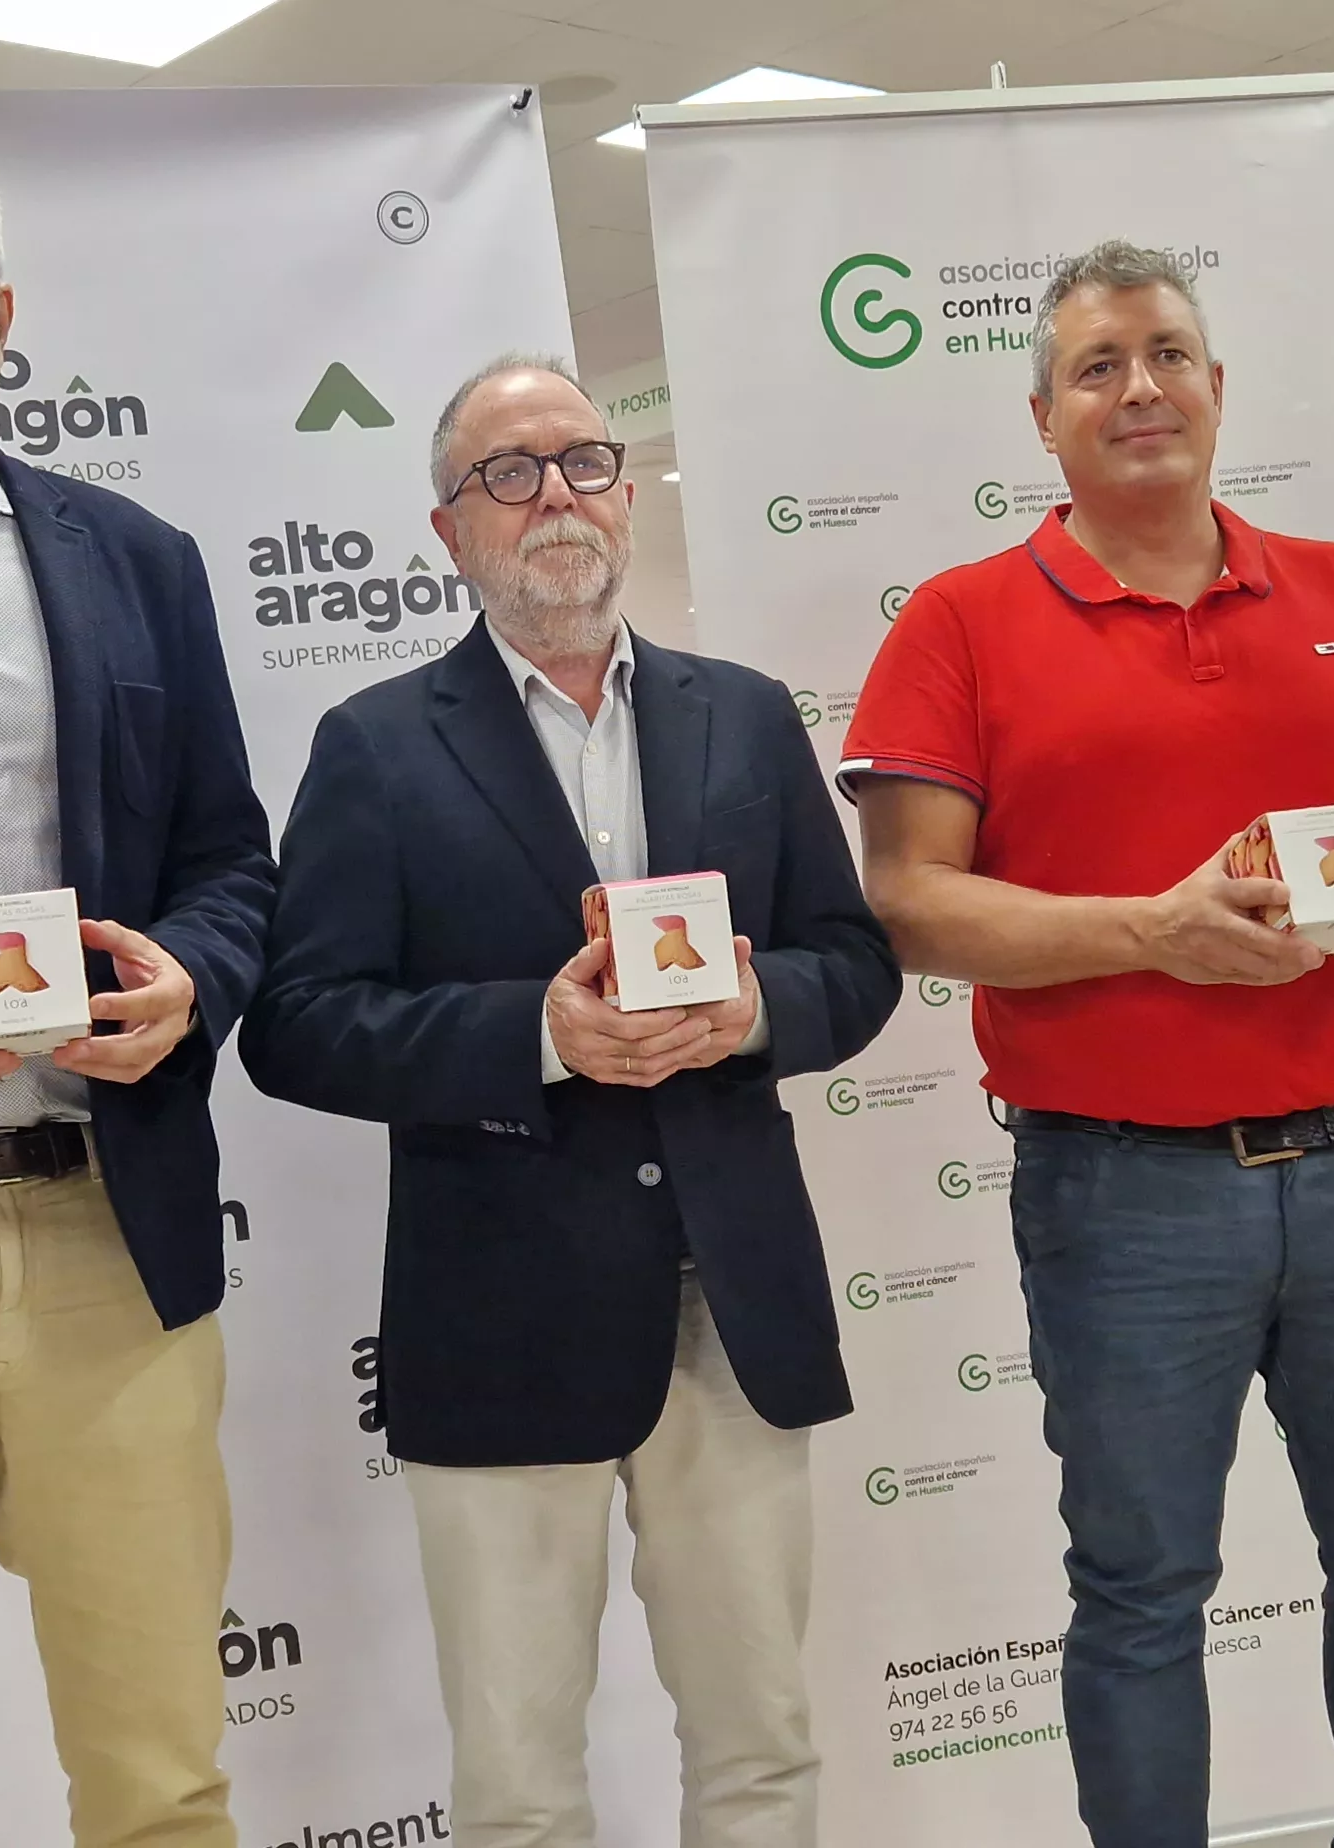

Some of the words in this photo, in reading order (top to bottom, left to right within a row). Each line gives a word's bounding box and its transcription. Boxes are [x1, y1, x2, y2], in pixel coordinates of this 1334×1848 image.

[942, 293, 1031, 319] contra
[946, 332, 979, 354] en
[607, 401, 616, 420] Y
[1218, 463, 1267, 476] asociación
[1269, 459, 1311, 472] española
[1013, 481, 1061, 492] asociación
[1219, 477, 1249, 487] contra
[1251, 475, 1259, 484] el
[1261, 473, 1293, 483] cáncer
[807, 493, 856, 506] asociación
[857, 492, 899, 505] española
[1013, 493, 1043, 503] contra
[1045, 492, 1053, 501] el
[1220, 490, 1232, 498] en
[1233, 487, 1268, 497] Huesca
[808, 507, 839, 518] contra
[840, 506, 848, 516] el
[850, 504, 881, 515] cáncer
[1015, 505, 1027, 514] en
[809, 519, 822, 529] en
[824, 518, 857, 528] Huesca
[248, 521, 373, 577] alto
[262, 636, 461, 670] SUPERMERCADO
[959, 994, 970, 1002] en
[865, 1073, 913, 1087] asociación
[914, 1068, 956, 1082] española
[866, 1088, 895, 1098] contra
[897, 1085, 905, 1094] el
[906, 1082, 938, 1093] cáncer
[867, 1101, 879, 1109] en
[880, 1097, 914, 1107] Huesca
[977, 1171, 1006, 1181] contra
[978, 1184, 990, 1193] en
[884, 1266, 932, 1280] asociación
[933, 1261, 976, 1274] española
[885, 1281, 915, 1292] contra
[916, 1278, 925, 1288] el
[926, 1274, 958, 1286] cáncer
[886, 1295, 898, 1304] en
[899, 1289, 934, 1302] Huesca
[997, 1363, 1026, 1374] contra
[998, 1376, 1010, 1385] en
[903, 1461, 952, 1476] asociación
[954, 1454, 996, 1469] española
[904, 1475, 934, 1486] contra
[936, 1472, 944, 1482] el
[946, 1468, 978, 1480] cáncer
[906, 1489, 918, 1498] en
[919, 1484, 954, 1497] Huesca
[884, 1641, 1000, 1682] Asociación
[1209, 1601, 1283, 1627] Cáncer
[1289, 1596, 1315, 1616] en
[887, 1684, 948, 1712] Ángel
[953, 1676, 981, 1698] de
[986, 1672, 1005, 1693] la
[889, 1717, 926, 1742] 974
[931, 1711, 955, 1734] 22
[960, 1705, 986, 1731] 56
[992, 1699, 1018, 1726] 56
